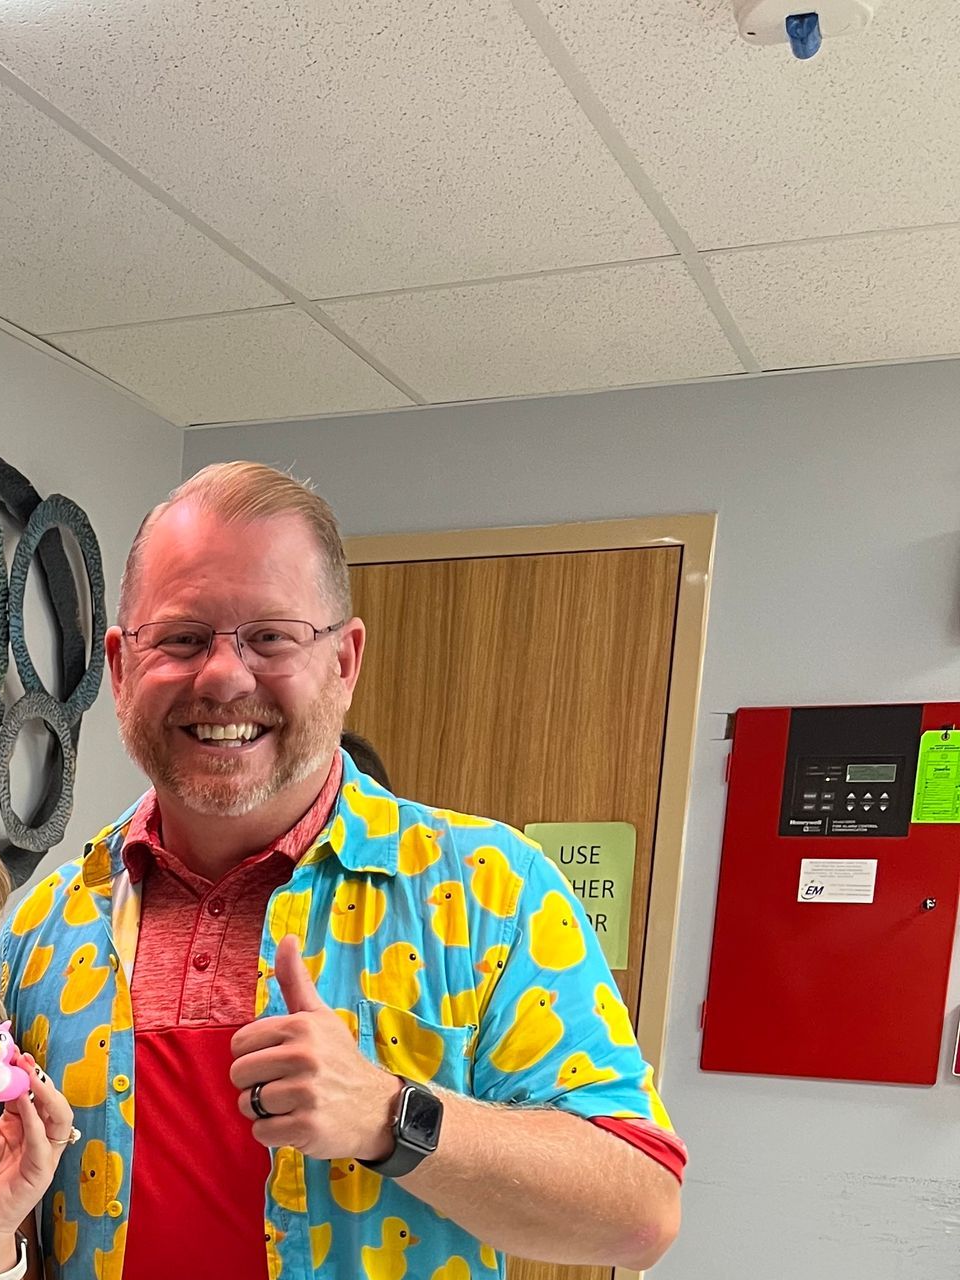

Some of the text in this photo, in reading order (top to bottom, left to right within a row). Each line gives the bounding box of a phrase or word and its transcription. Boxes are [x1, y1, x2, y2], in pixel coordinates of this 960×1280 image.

[560, 845, 601, 865] USE
[569, 879, 614, 899] HER
[805, 885, 824, 896] EM
